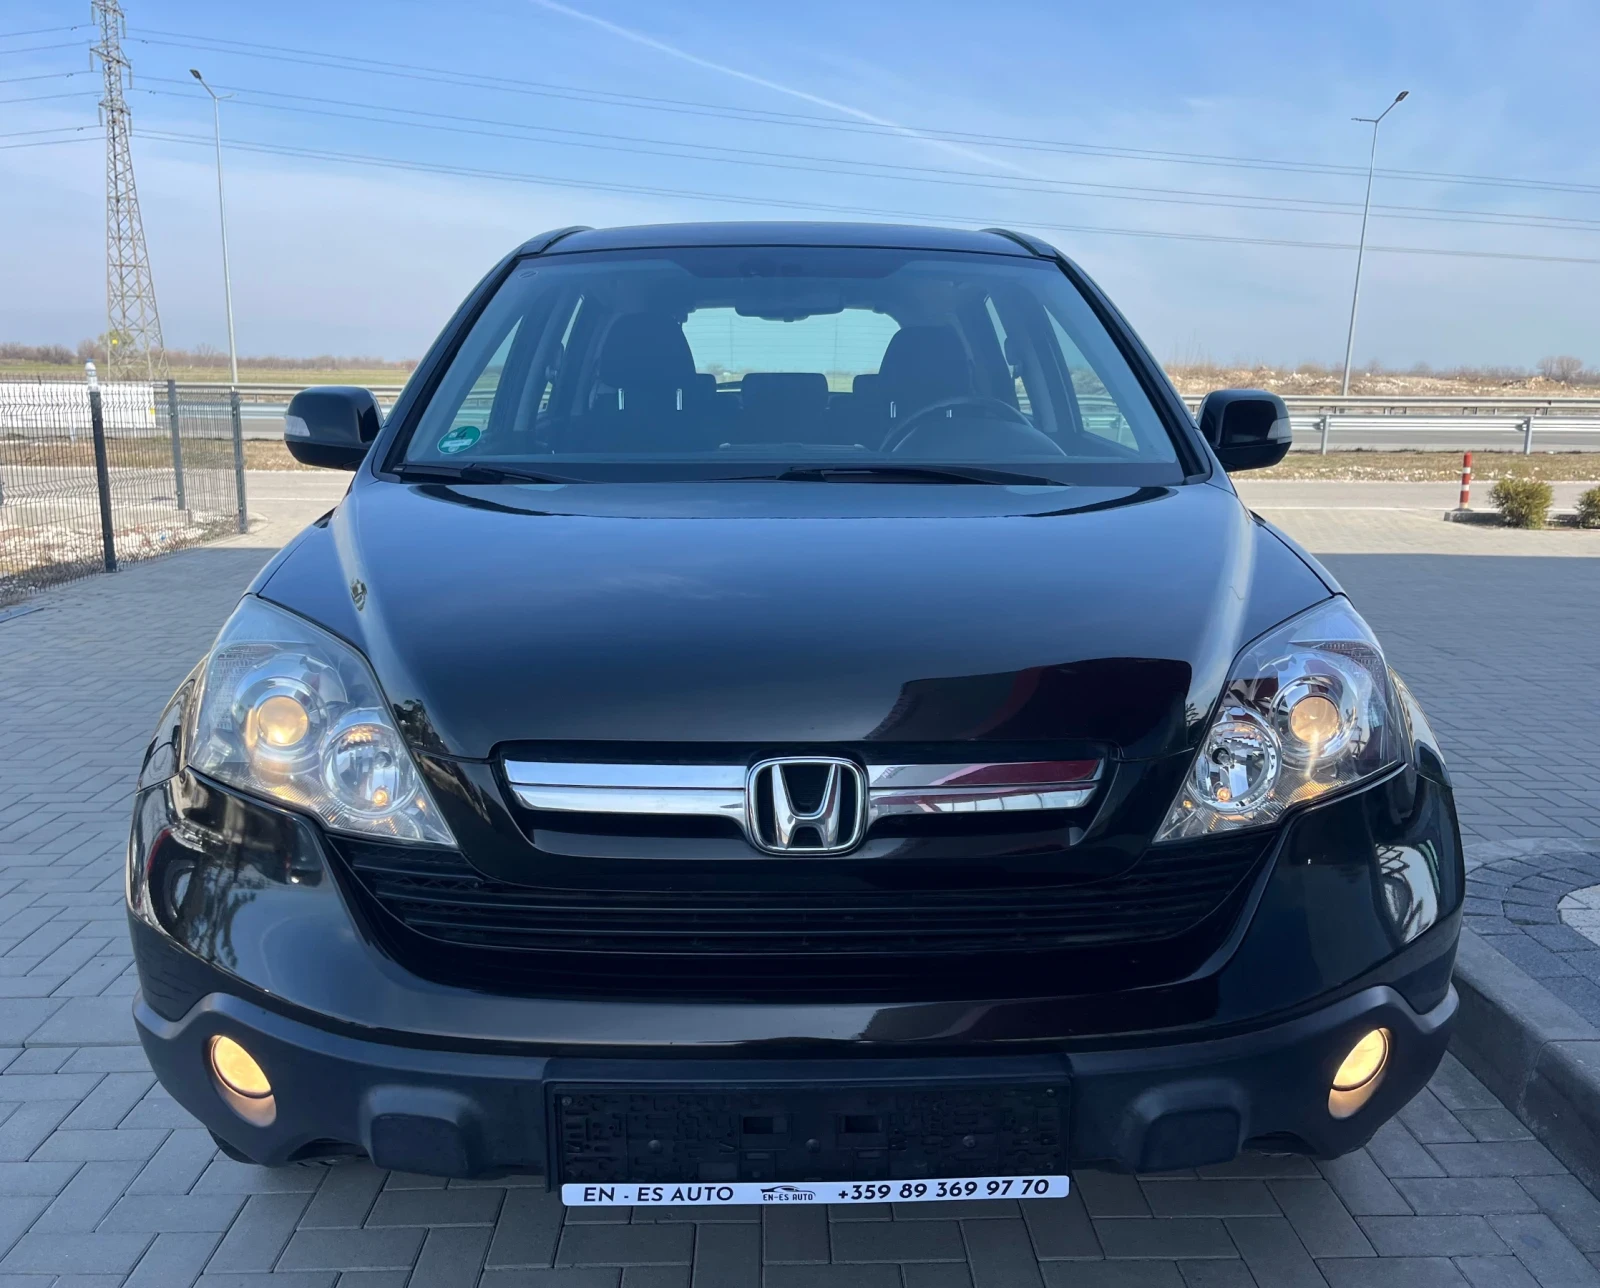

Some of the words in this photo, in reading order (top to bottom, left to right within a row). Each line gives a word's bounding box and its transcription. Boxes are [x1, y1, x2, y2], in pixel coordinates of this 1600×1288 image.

[583, 1187, 615, 1202] EN
[637, 1187, 663, 1202] ES
[670, 1187, 734, 1202] AUTO
[763, 1194, 789, 1202] EN-ES
[792, 1193, 814, 1201] AUTO
[838, 1184, 891, 1201] +359
[899, 1183, 927, 1199] 89
[936, 1182, 978, 1198] 369
[986, 1180, 1014, 1196] 97
[1021, 1179, 1049, 1195] 70
